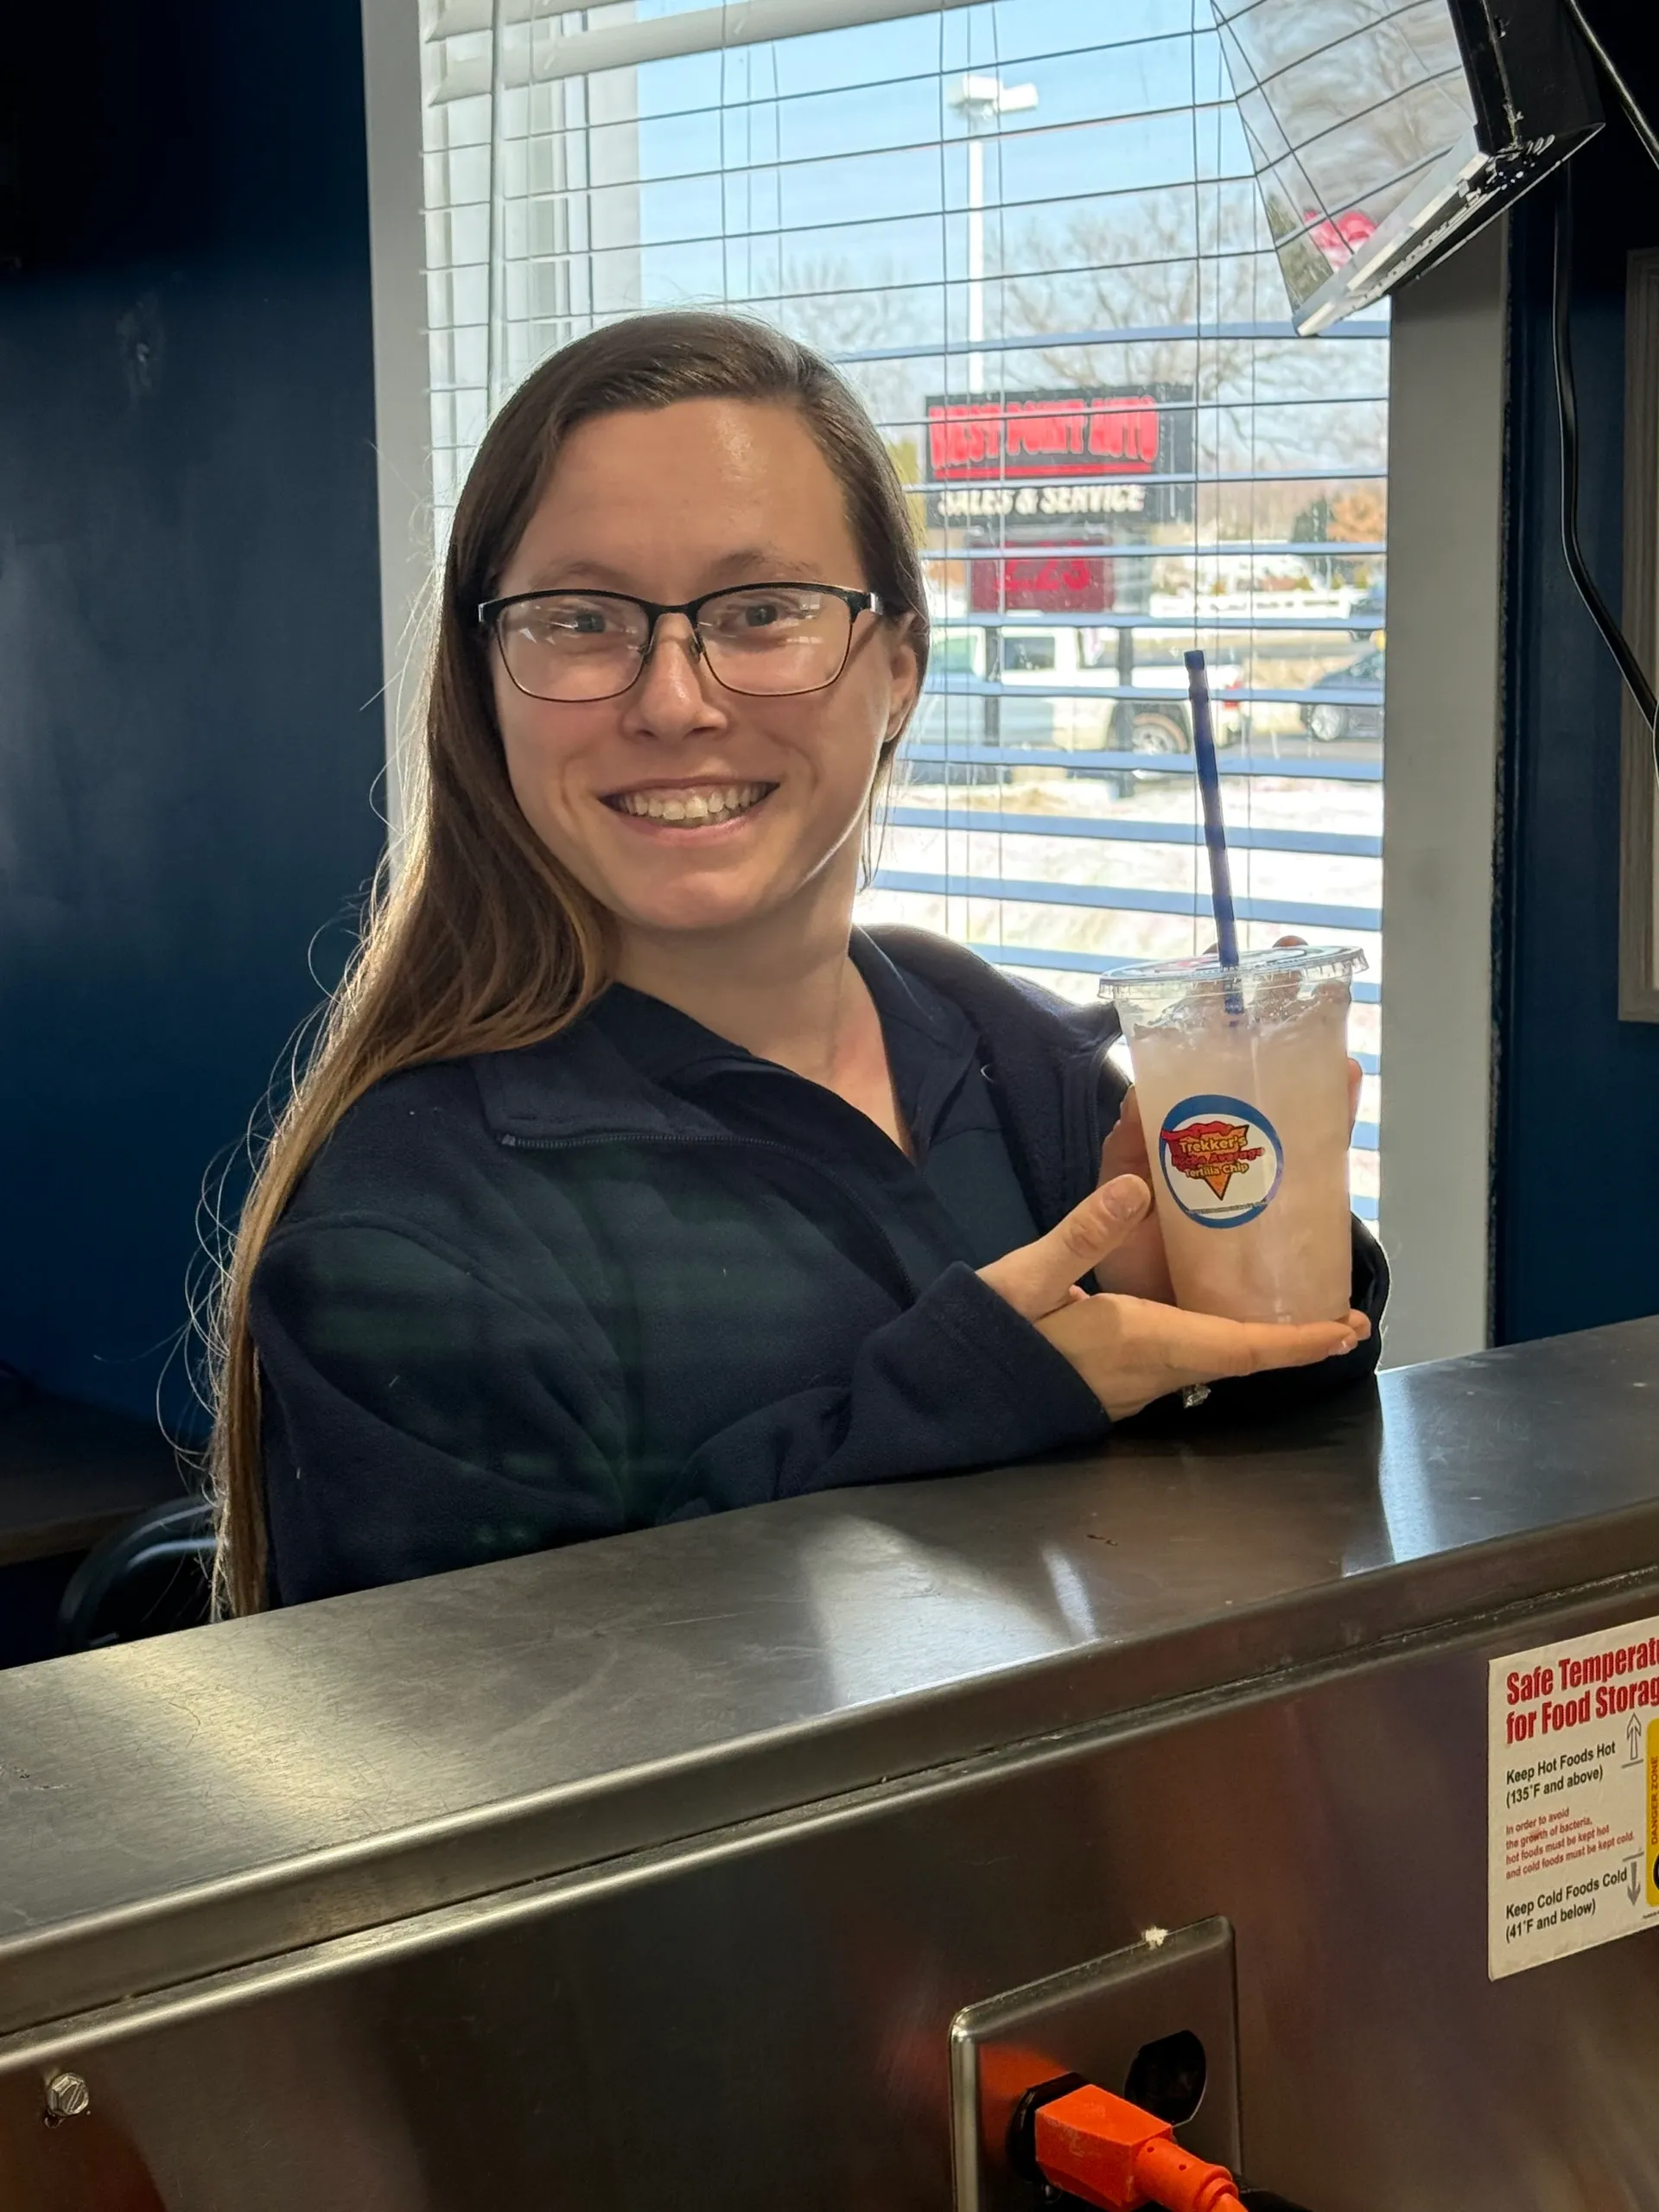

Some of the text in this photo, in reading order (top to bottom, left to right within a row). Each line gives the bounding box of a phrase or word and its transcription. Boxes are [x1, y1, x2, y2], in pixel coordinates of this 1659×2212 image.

[938, 490, 1015, 516] SALES
[1039, 485, 1147, 514] SERVICE
[1178, 1135, 1248, 1154] Trekker's
[1222, 1162, 1249, 1173] Chip
[1507, 1637, 1659, 1705] Safe Temperat
[1506, 1711, 1537, 1745] for
[1541, 1690, 1591, 1734] Food
[1506, 1740, 1615, 1785] Keep Hot Foods Hot
[1543, 1776, 1564, 1795] and
[1567, 1764, 1603, 1788] above)
[1650, 1755, 1659, 1846] DANGER ZONE
[1505, 1807, 1569, 1835] In order to avoid
[1505, 1840, 1519, 1851] the
[1520, 1829, 1548, 1848] growth
[1549, 1825, 1558, 1836] of
[1505, 1823, 1610, 1866] hot foods must be kept hot
[1505, 1866, 1522, 1880] and
[1522, 1859, 1541, 1875] cold
[1541, 1852, 1564, 1869] foods
[1565, 1846, 1586, 1860] must
[1586, 1843, 1597, 1854] be
[1598, 1836, 1616, 1851] kept
[1506, 1866, 1628, 1920] Keep Cold Foods Cold
[1536, 1910, 1557, 1930] and
[1560, 1897, 1597, 1922] below)
